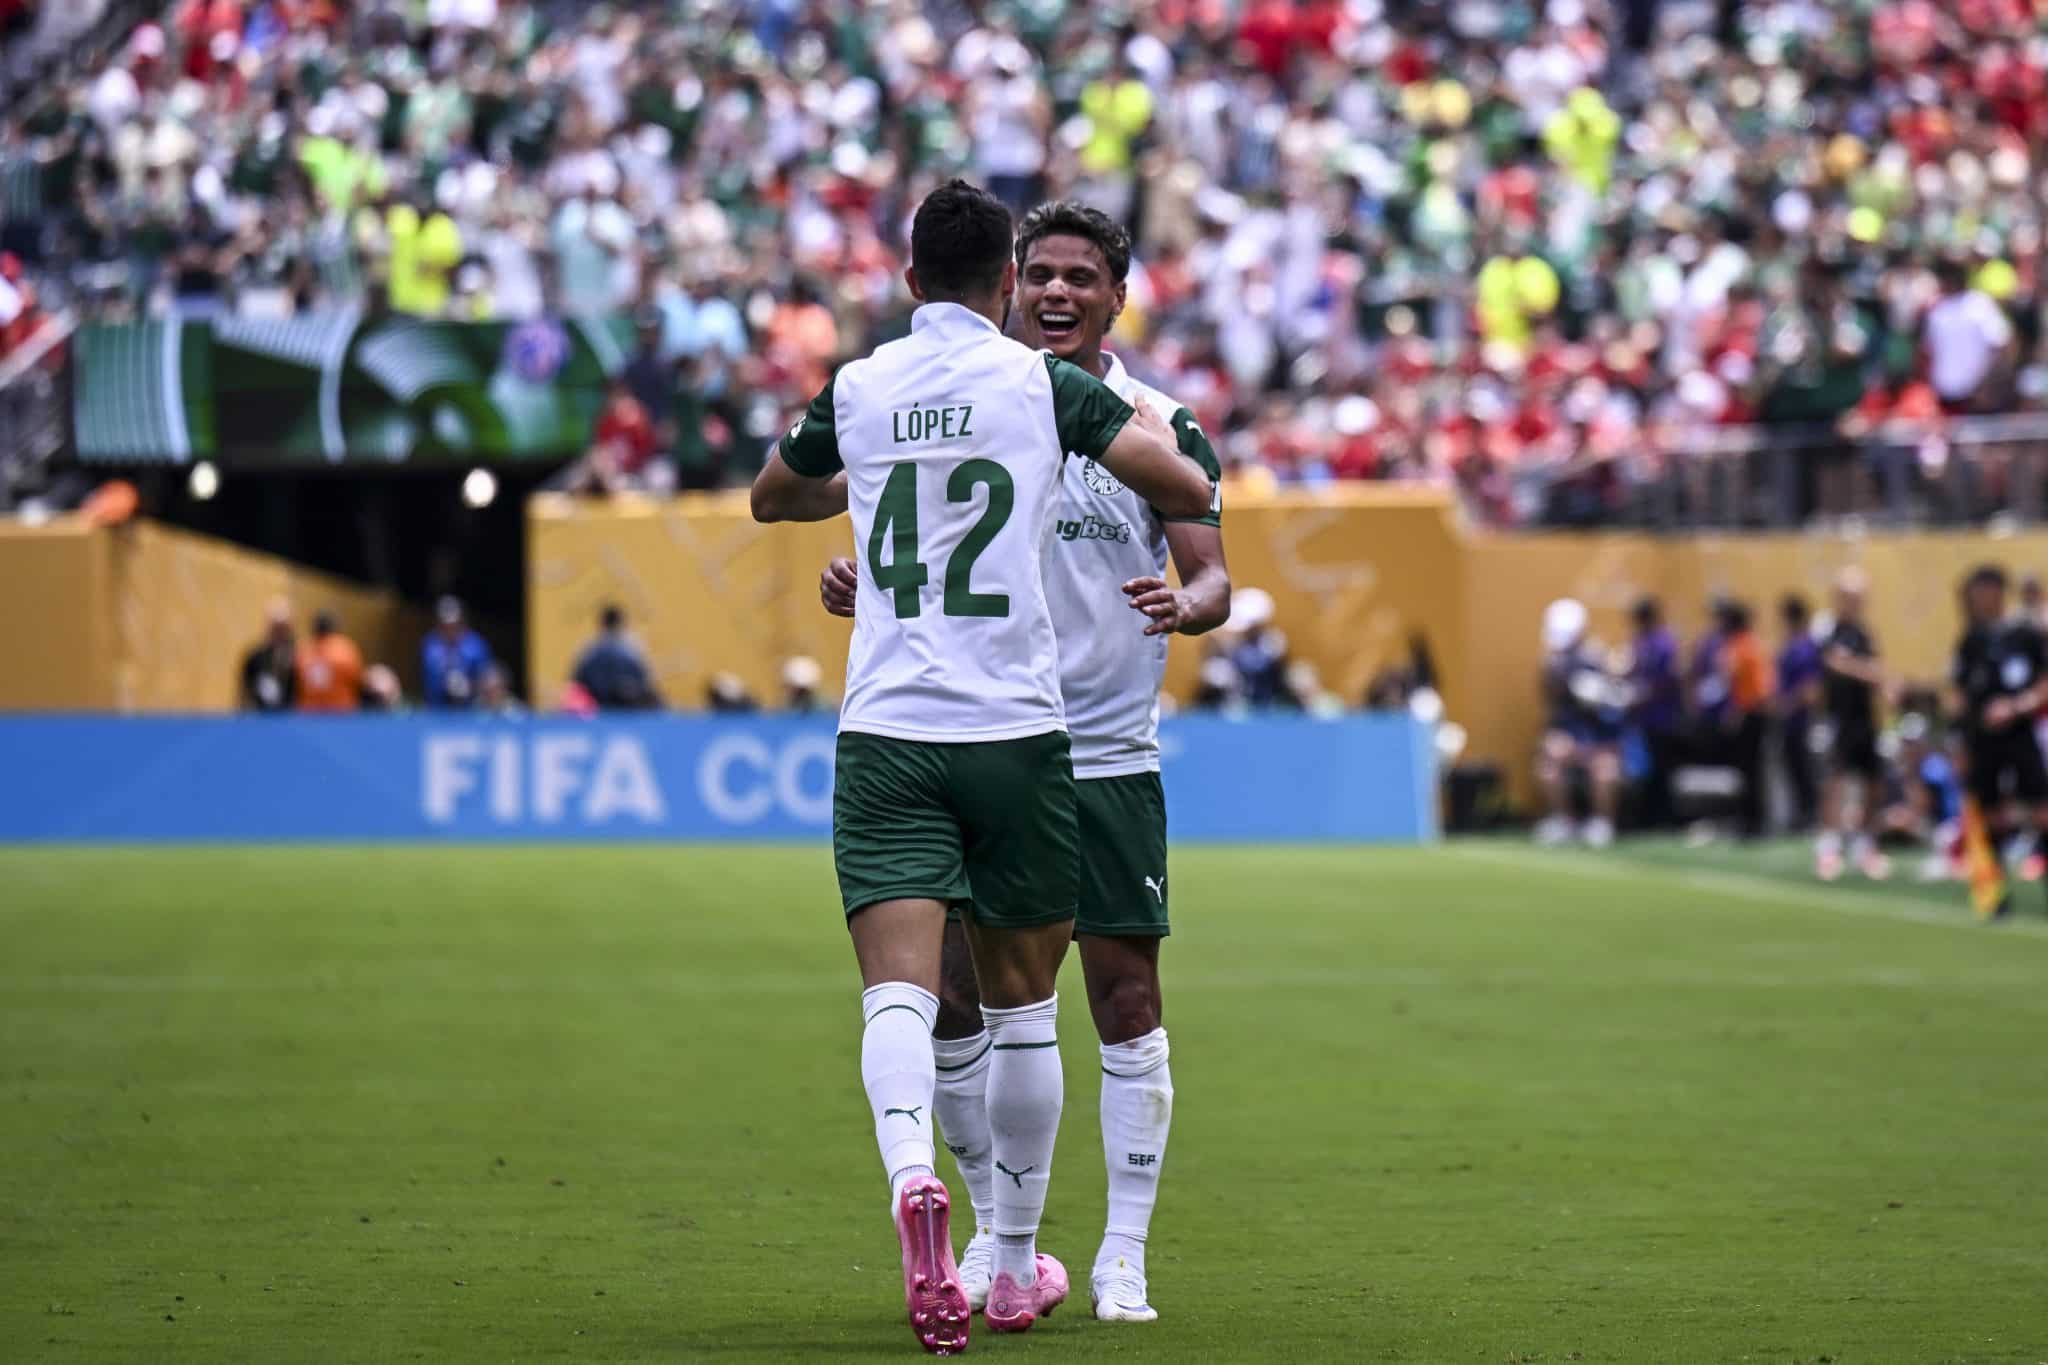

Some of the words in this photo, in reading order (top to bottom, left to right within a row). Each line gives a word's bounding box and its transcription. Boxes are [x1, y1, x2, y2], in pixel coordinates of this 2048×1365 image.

[893, 402, 972, 443] LÓPEZ
[868, 459, 1014, 619] 42
[423, 734, 666, 820] FIFA
[1128, 1153, 1156, 1166] SEP
